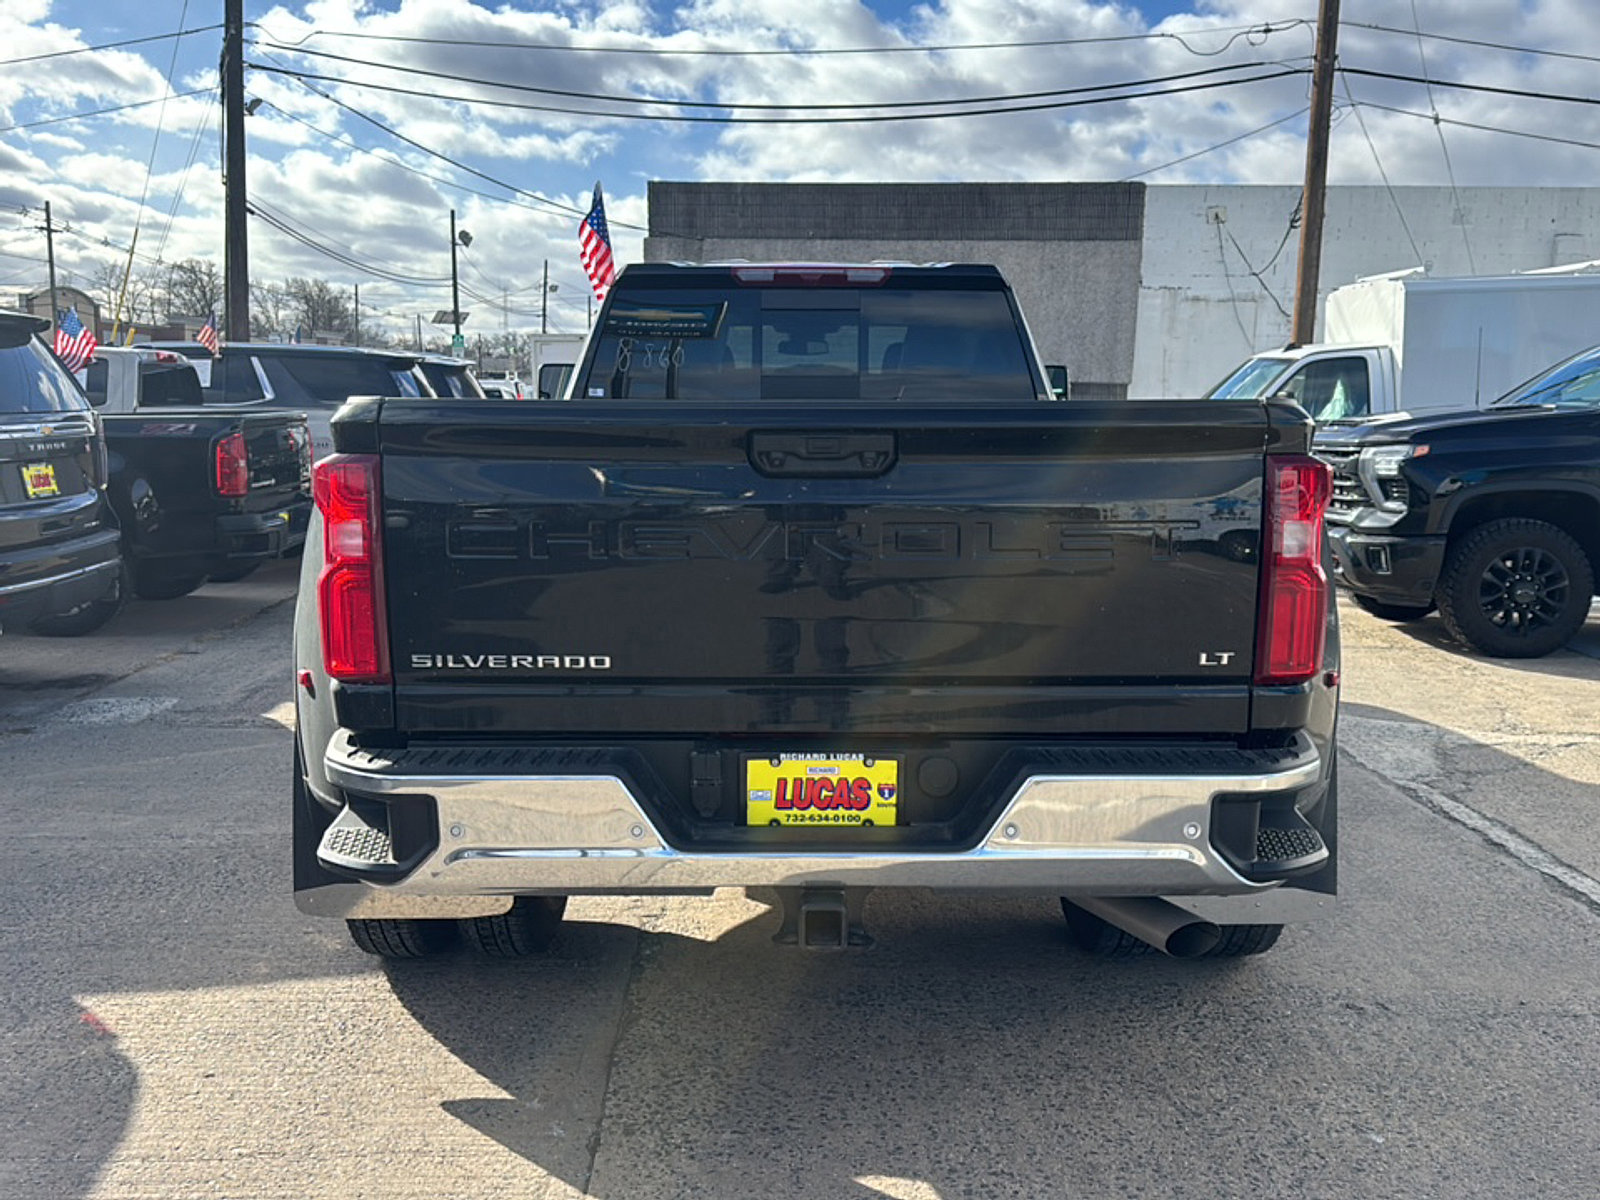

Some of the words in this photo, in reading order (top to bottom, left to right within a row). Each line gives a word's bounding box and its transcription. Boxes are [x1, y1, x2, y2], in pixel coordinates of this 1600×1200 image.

[446, 519, 1200, 560] CHEVROLET
[410, 653, 612, 670] SILVERADO
[1199, 650, 1235, 666] LT
[779, 752, 826, 761] RICHARD
[829, 752, 864, 761] LUCAS
[775, 777, 872, 811] LUCAS
[785, 813, 861, 823] 732-634-0100
